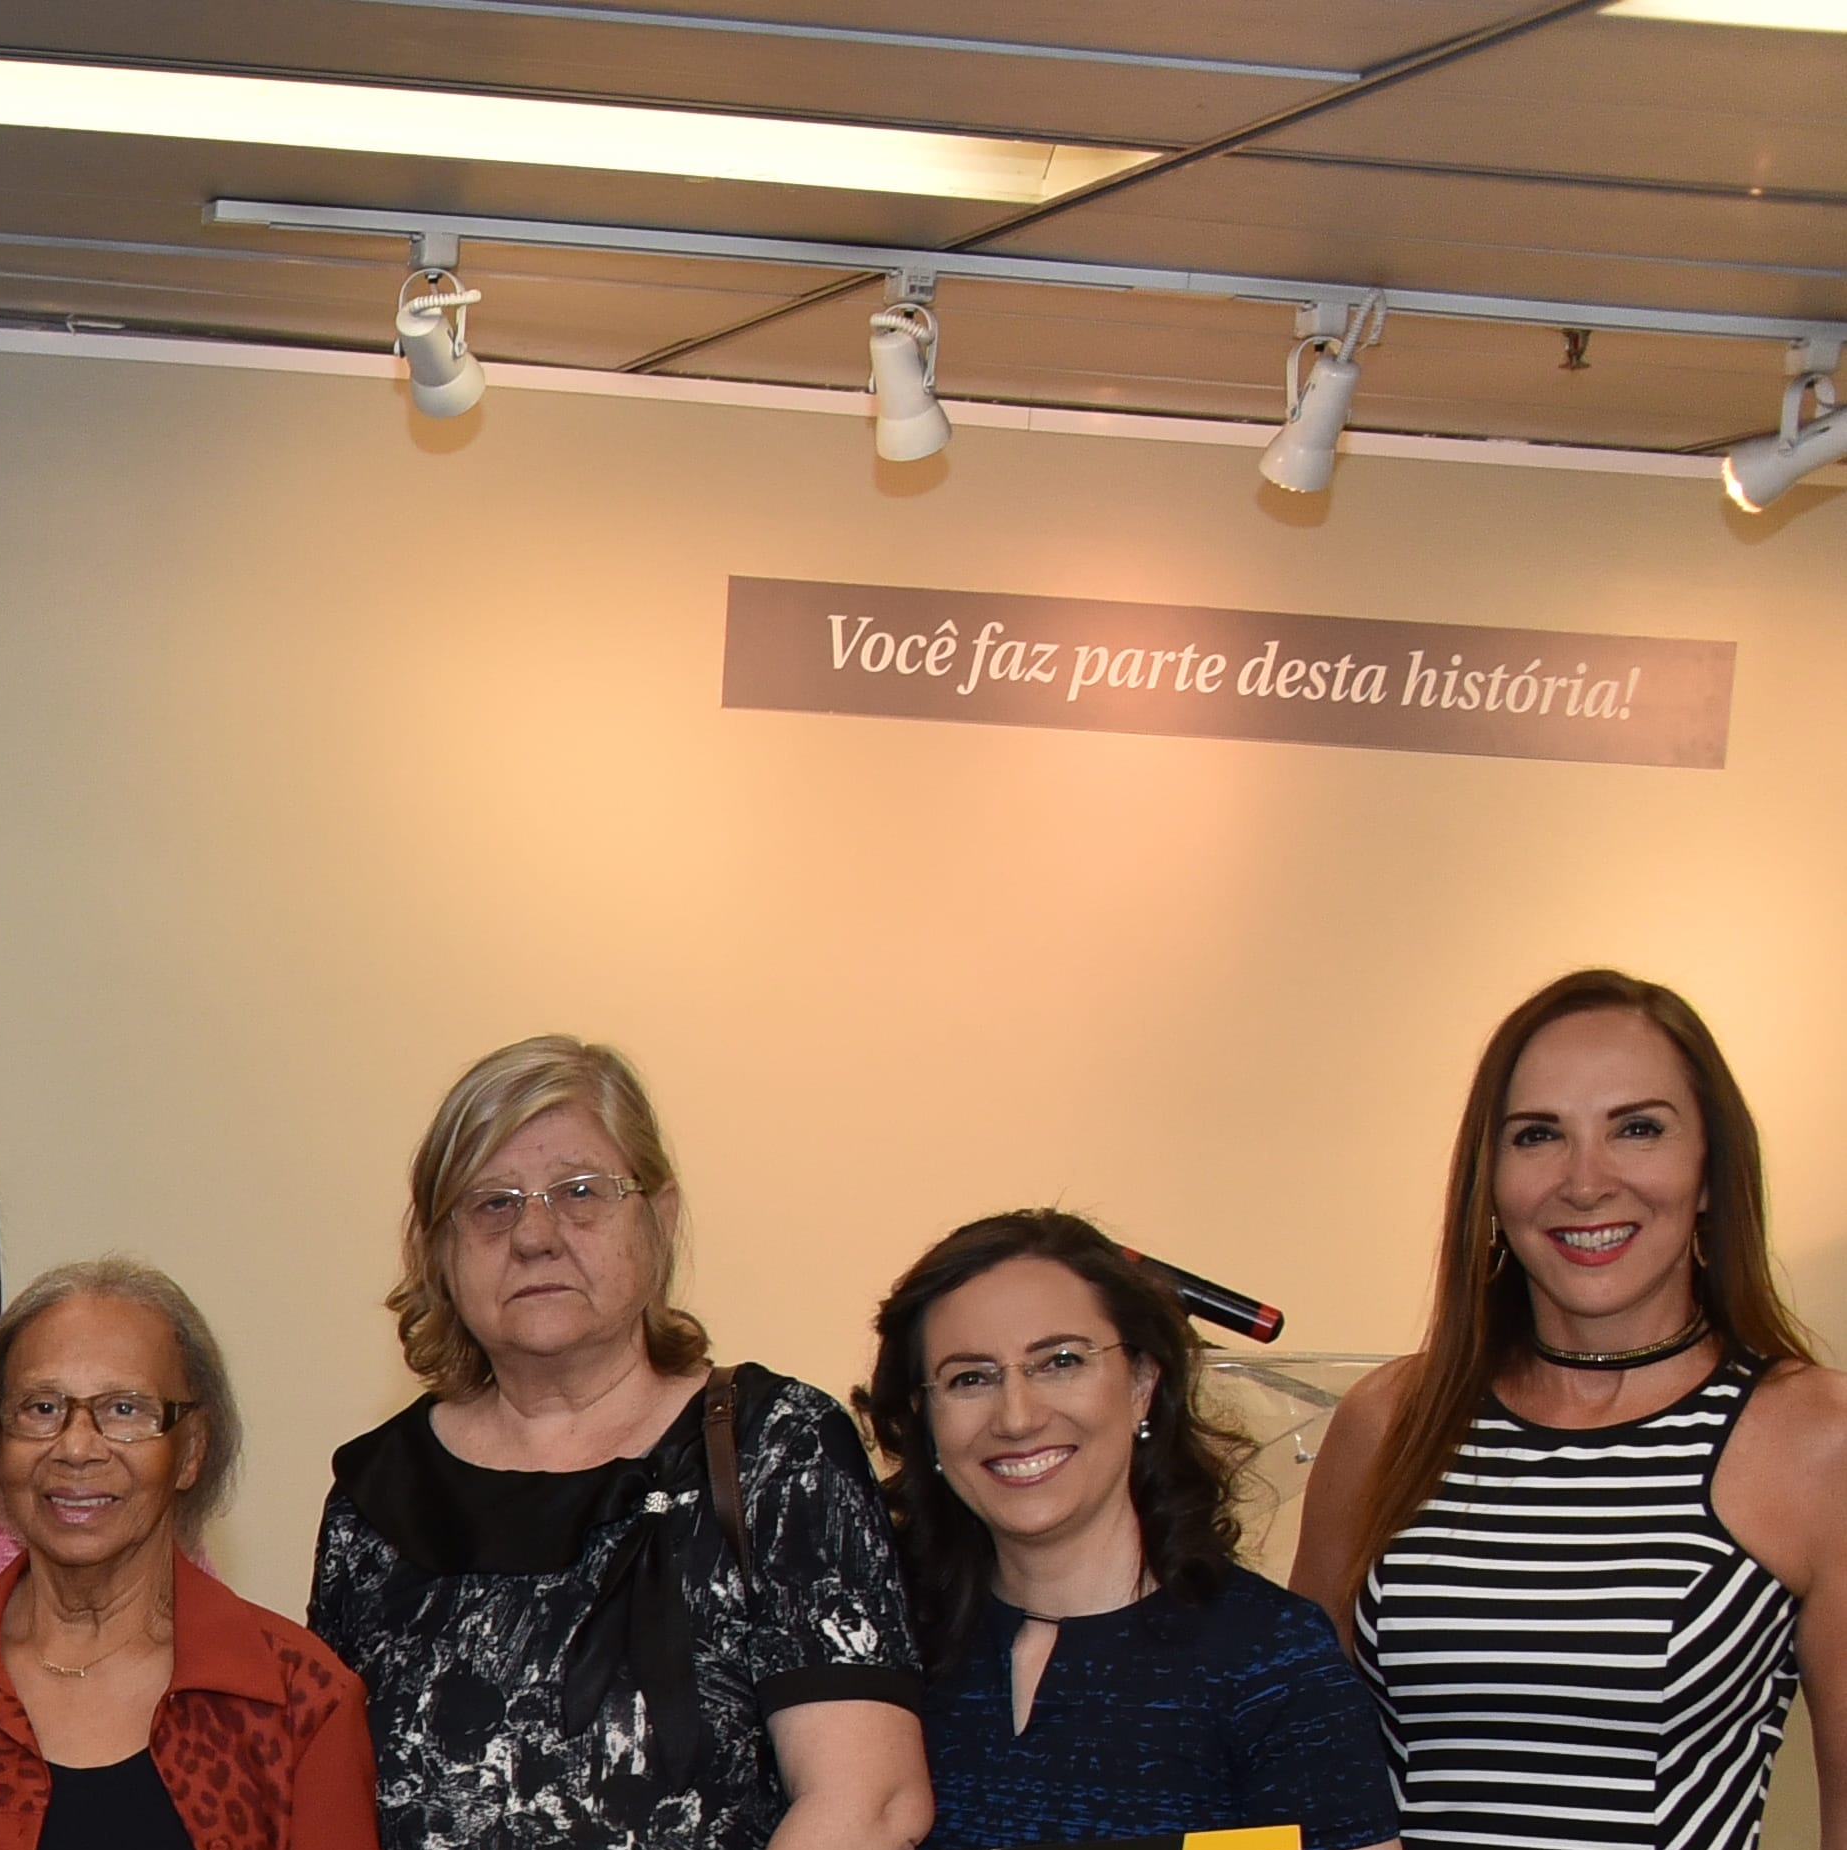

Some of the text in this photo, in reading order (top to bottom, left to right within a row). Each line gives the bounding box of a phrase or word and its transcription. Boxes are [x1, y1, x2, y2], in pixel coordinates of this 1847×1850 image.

[827, 614, 1641, 720] Você faz parte desta história!
